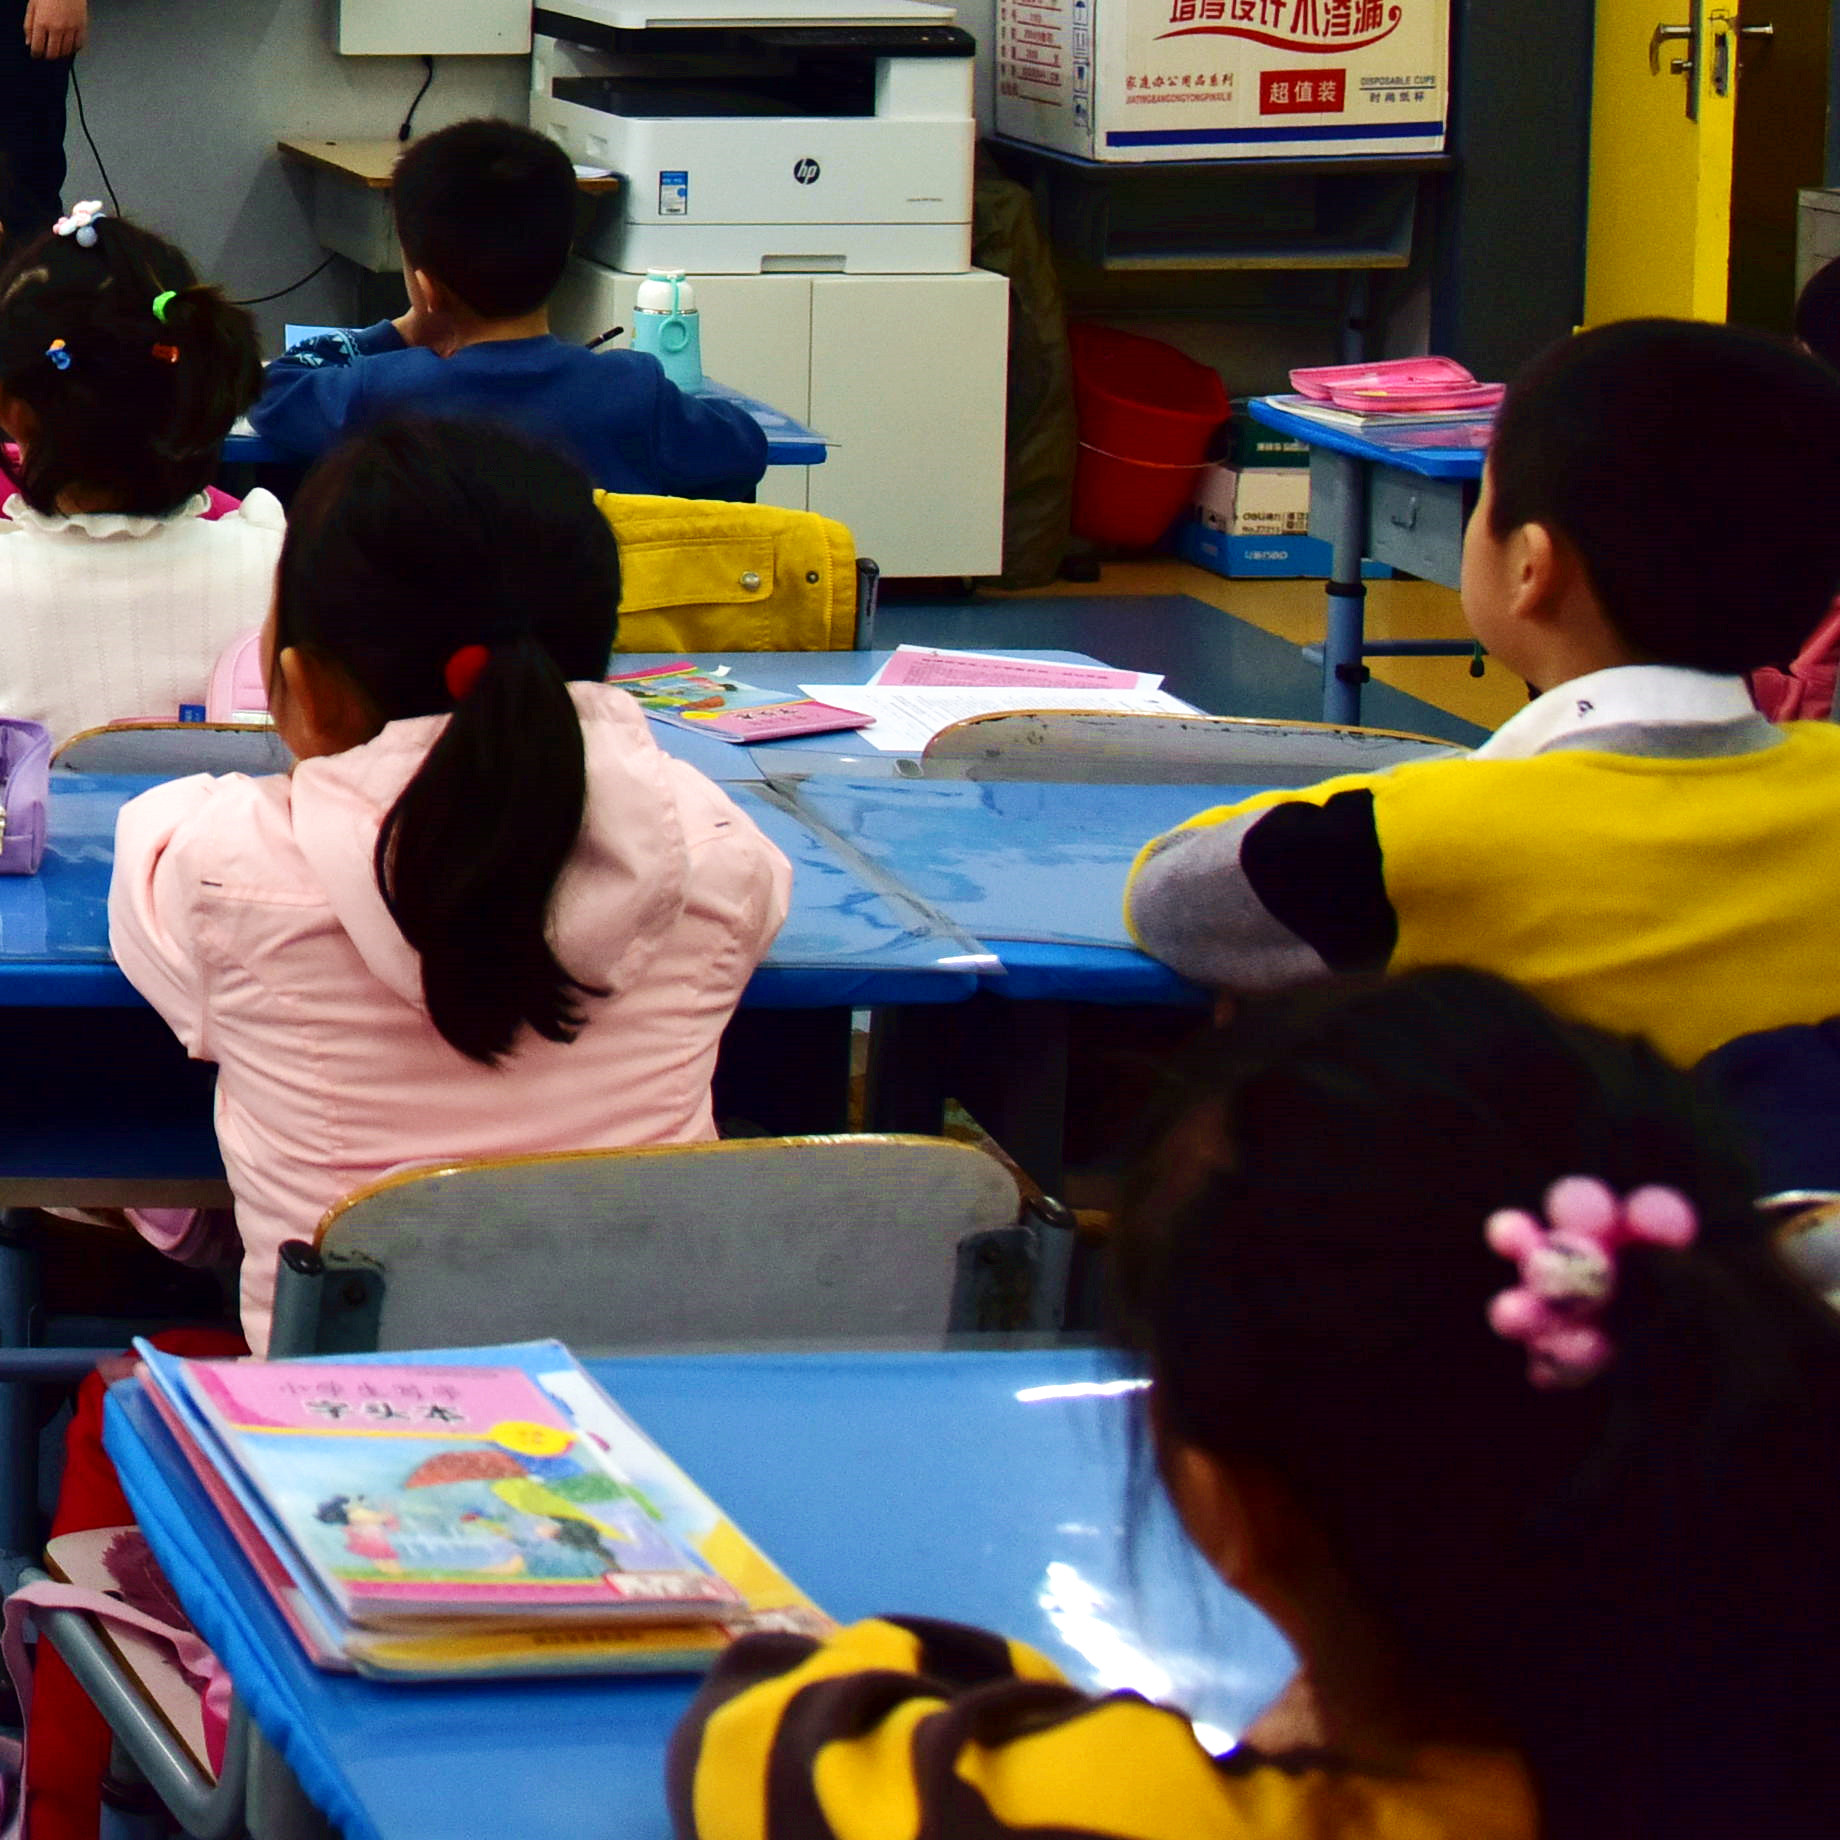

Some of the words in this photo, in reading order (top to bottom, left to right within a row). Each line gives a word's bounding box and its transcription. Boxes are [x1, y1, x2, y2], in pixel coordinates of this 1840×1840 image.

[1269, 80, 1337, 104] 超值装
[796, 158, 820, 184] hp
